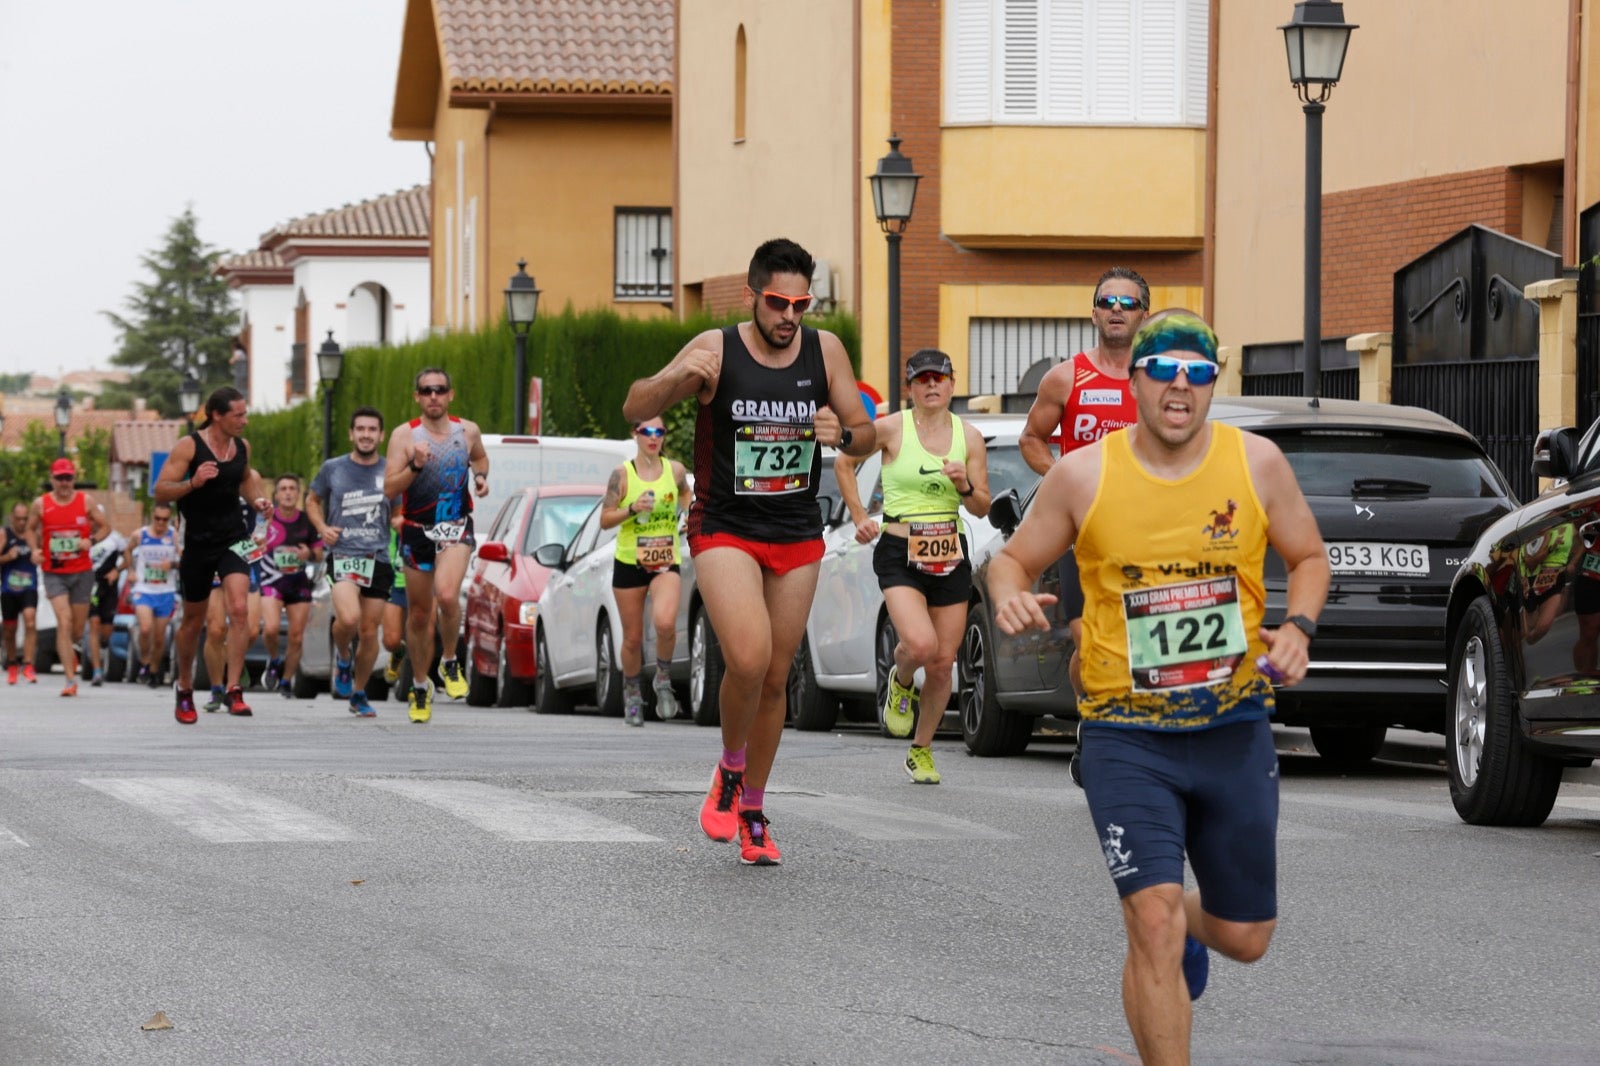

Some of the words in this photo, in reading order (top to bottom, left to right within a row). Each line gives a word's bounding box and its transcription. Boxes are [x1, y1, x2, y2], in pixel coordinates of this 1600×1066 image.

[731, 399, 816, 417] GRANADA
[750, 445, 802, 471] 732
[642, 549, 673, 562] 2048
[917, 538, 957, 557] 2094
[1329, 546, 1372, 566] 953
[1380, 547, 1423, 568] KGG
[343, 558, 367, 573] 681
[1149, 588, 1170, 604] GRAN
[1170, 585, 1199, 600] PREMIO
[1200, 583, 1210, 597] DE
[1149, 612, 1227, 657] 122
